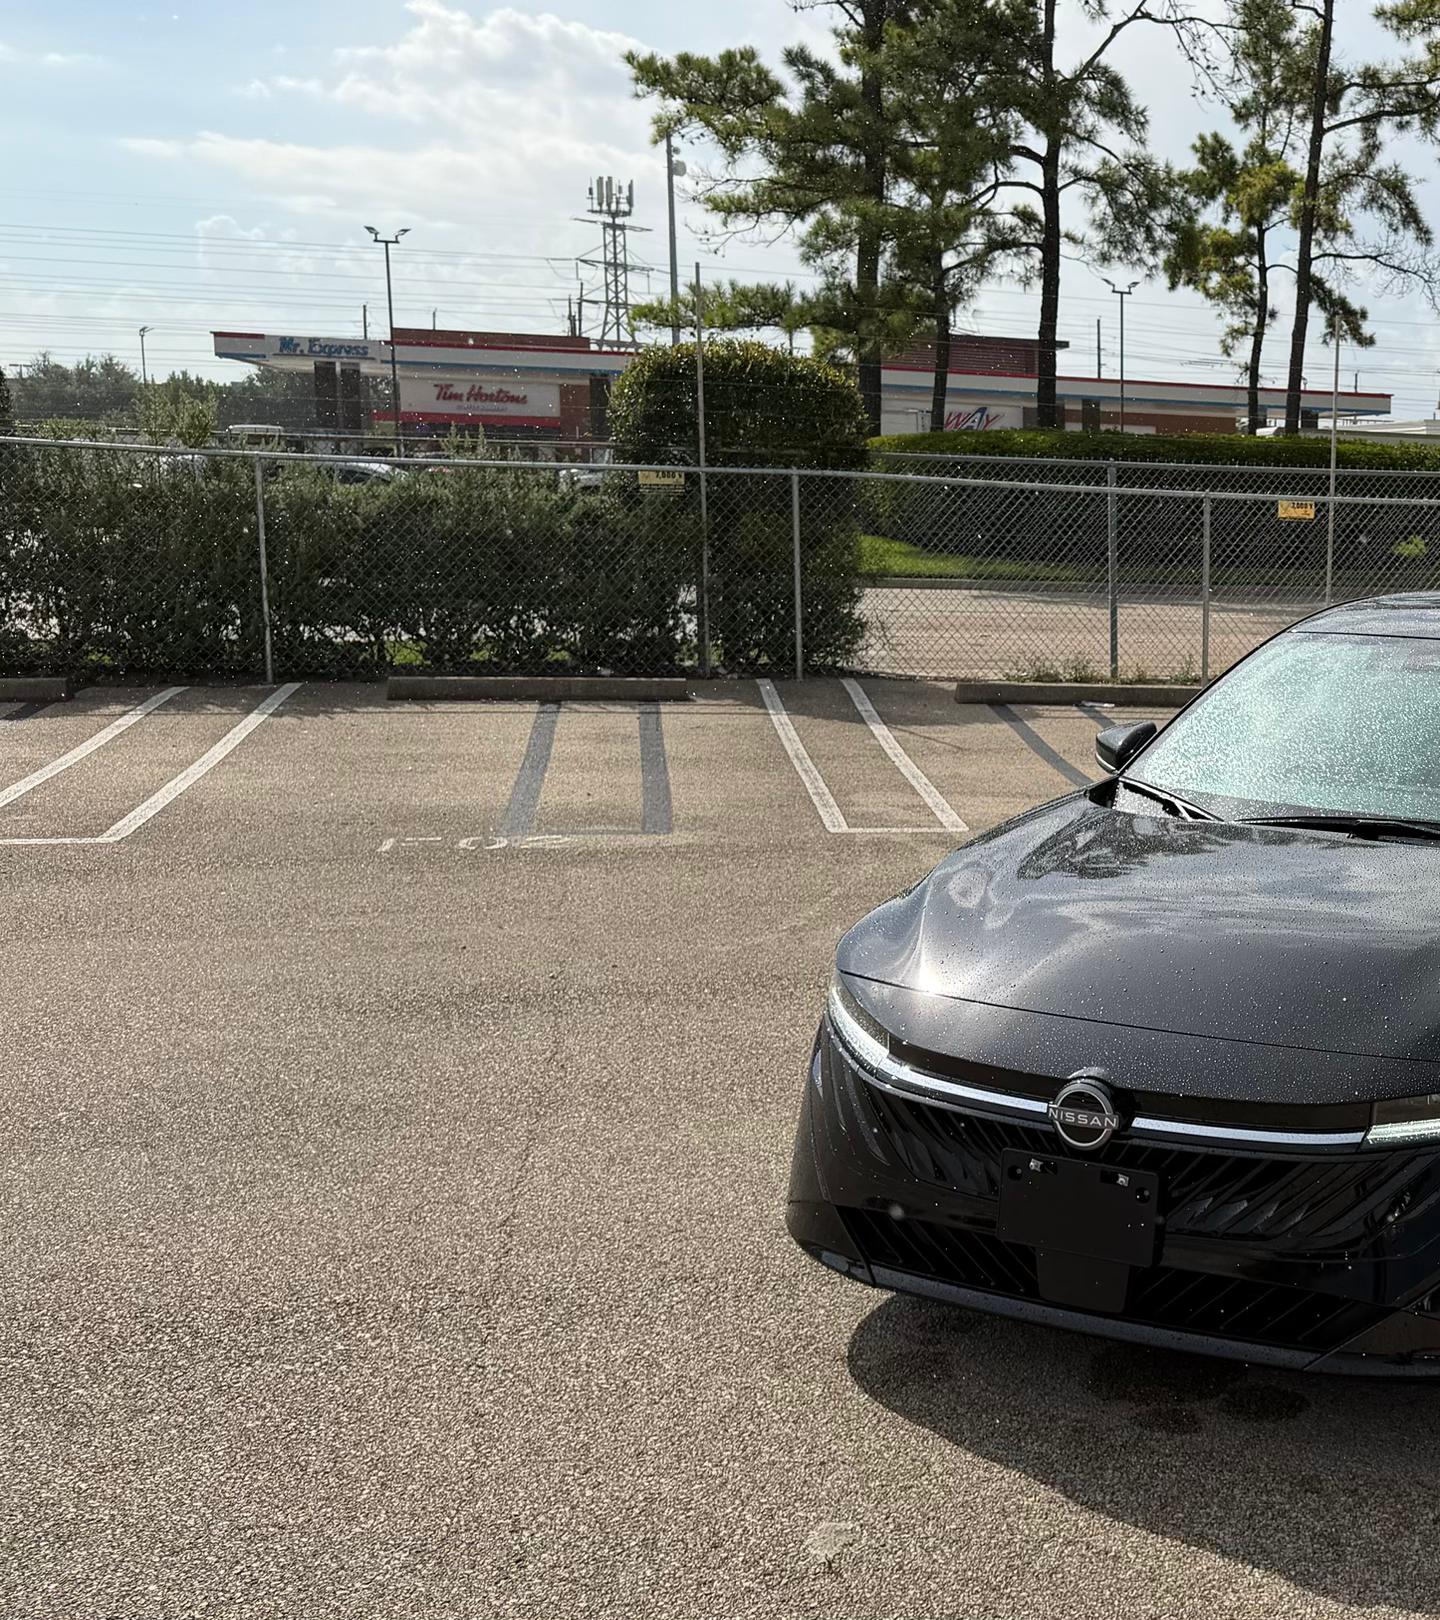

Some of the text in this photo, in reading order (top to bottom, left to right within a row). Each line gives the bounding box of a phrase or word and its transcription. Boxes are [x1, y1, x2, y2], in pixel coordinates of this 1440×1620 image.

[279, 337, 369, 358] Mr. Express
[433, 383, 528, 405] Tim Hortons
[1048, 1107, 1117, 1128] NISSAN
